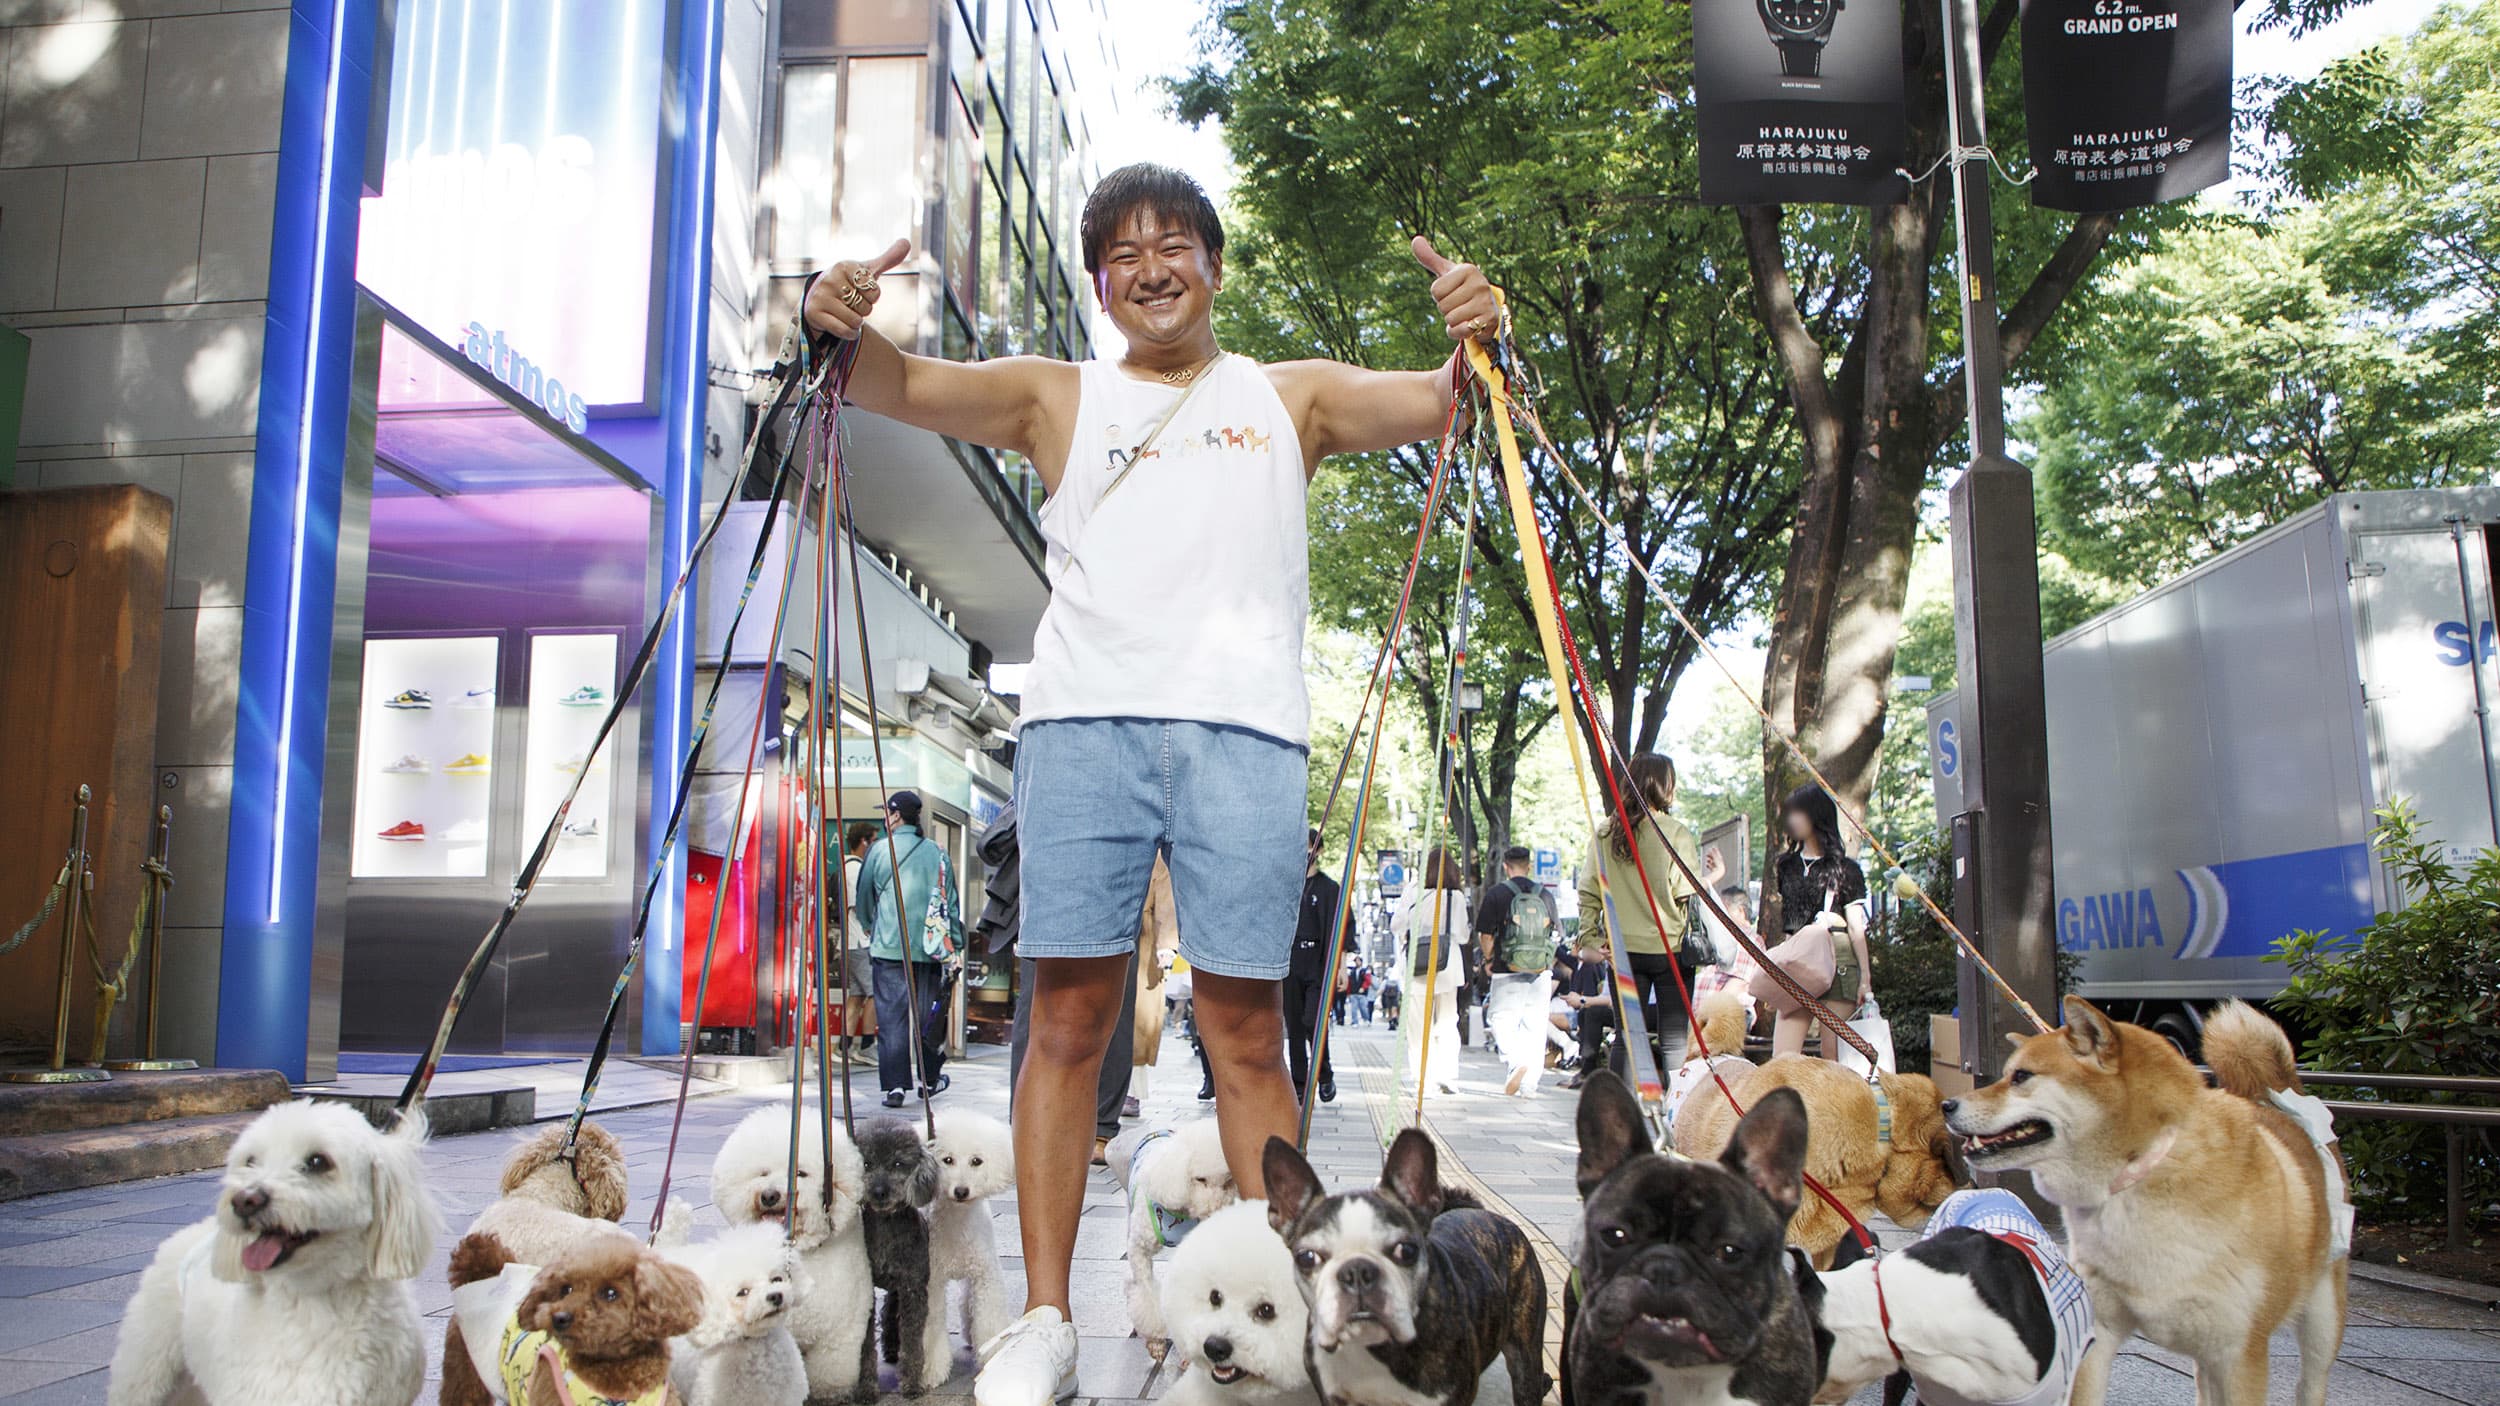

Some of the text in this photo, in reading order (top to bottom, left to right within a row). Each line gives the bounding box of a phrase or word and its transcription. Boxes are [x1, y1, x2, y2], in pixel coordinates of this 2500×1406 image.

[2095, 0, 2142, 15] 6.2 FRI.
[2064, 13, 2177, 34] GRAND OPEN
[1759, 127, 1848, 140] HARAJUKU
[2073, 127, 2168, 145] HARAJUKU
[466, 321, 588, 435] atmos
[1938, 719, 1961, 778] S
[1537, 850, 1558, 875] P
[2058, 887, 2164, 952] GAWA
